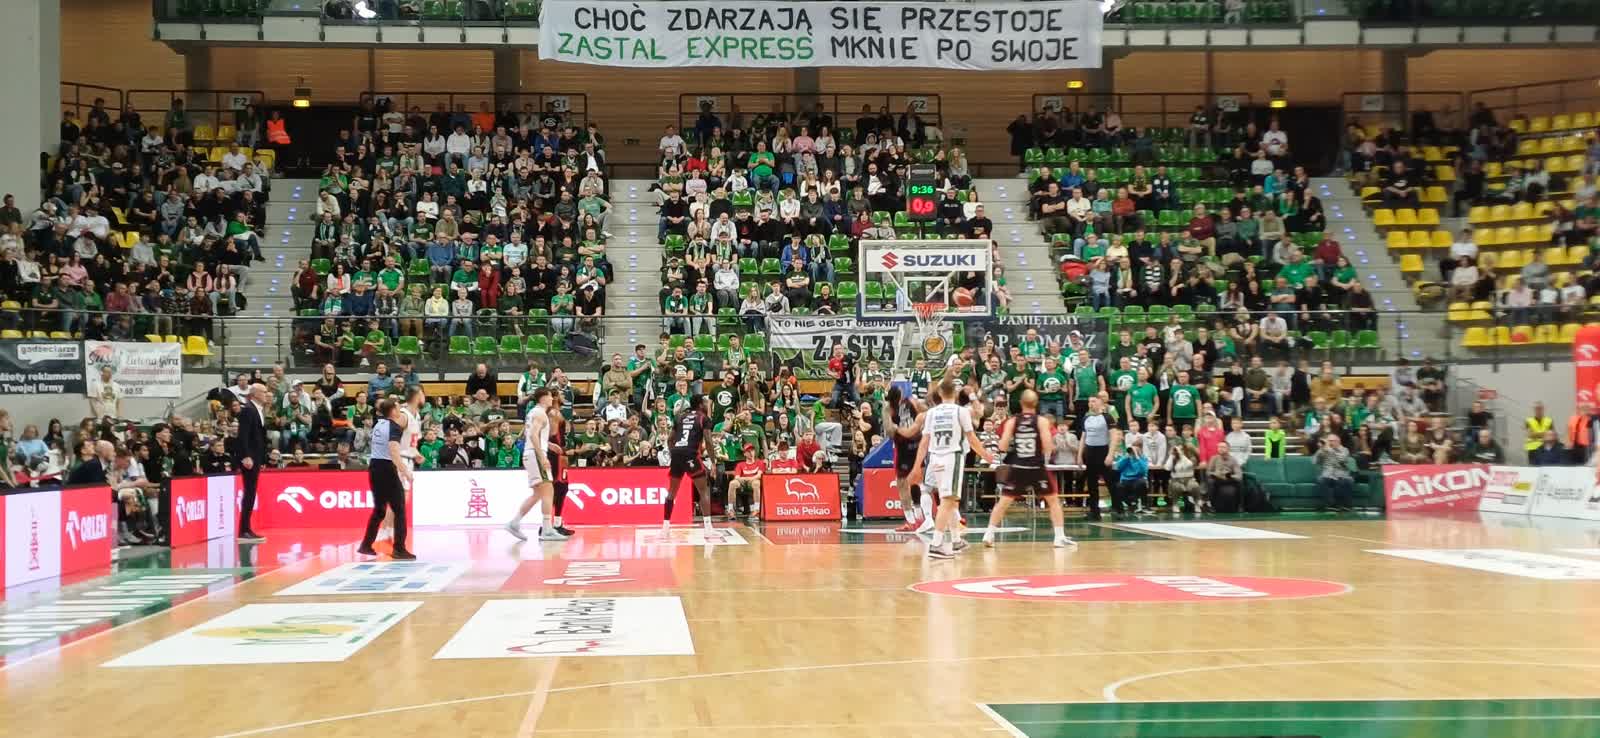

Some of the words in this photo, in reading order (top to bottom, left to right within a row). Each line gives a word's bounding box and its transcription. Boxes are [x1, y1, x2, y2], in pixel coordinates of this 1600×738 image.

[667, 8, 813, 36] ZDARZAJĄ
[830, 7, 881, 33] SIĘ
[901, 7, 1063, 33] PRZESTOJE
[558, 33, 667, 60] ZASTAL
[687, 35, 814, 60] EXPRESS
[830, 36, 919, 59] MKNIE
[937, 38, 972, 61] PO
[991, 38, 1078, 62] SWOJE
[911, 185, 934, 194] 9:36
[903, 254, 976, 267] SUZUKI
[776, 319, 792, 328] TO
[795, 319, 815, 328] NIE
[812, 334, 913, 362] ZASTA
[2, 383, 37, 393] Twojej
[39, 383, 64, 393] firmy
[776, 506, 800, 516] Bank
[802, 506, 831, 516] Pekao
